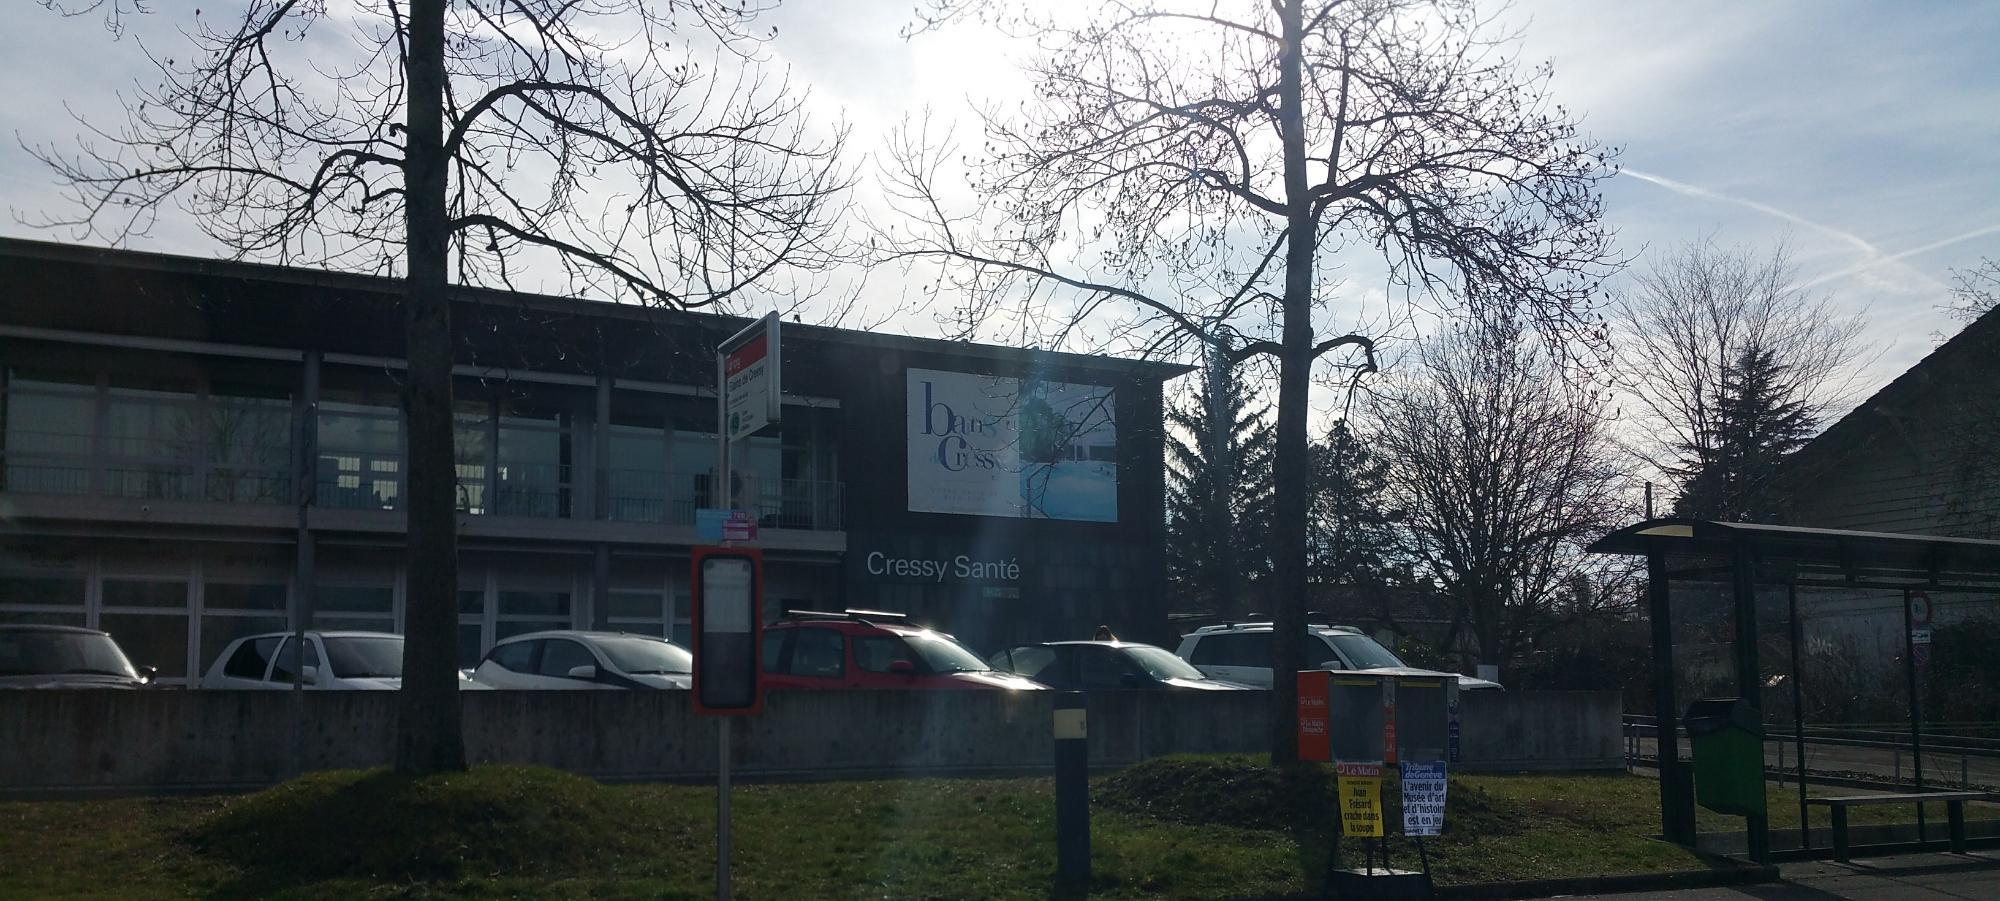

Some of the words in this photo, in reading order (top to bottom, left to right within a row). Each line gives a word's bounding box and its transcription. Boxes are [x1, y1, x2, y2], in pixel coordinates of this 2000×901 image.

[866, 551, 948, 583] Cressy
[954, 555, 1020, 580] Santé
[1346, 766, 1357, 775] Le
[1358, 766, 1379, 776] Matin
[1405, 764, 1433, 772] Tribune
[1404, 781, 1432, 791] L'avenir
[1434, 781, 1443, 791] du
[1353, 787, 1366, 797] Ivan
[1404, 791, 1426, 802] Musée
[1427, 792, 1444, 803] d'art
[1404, 804, 1410, 814] et
[1363, 811, 1380, 820] dans
[1408, 815, 1419, 825] est
[1421, 817, 1431, 825] en
